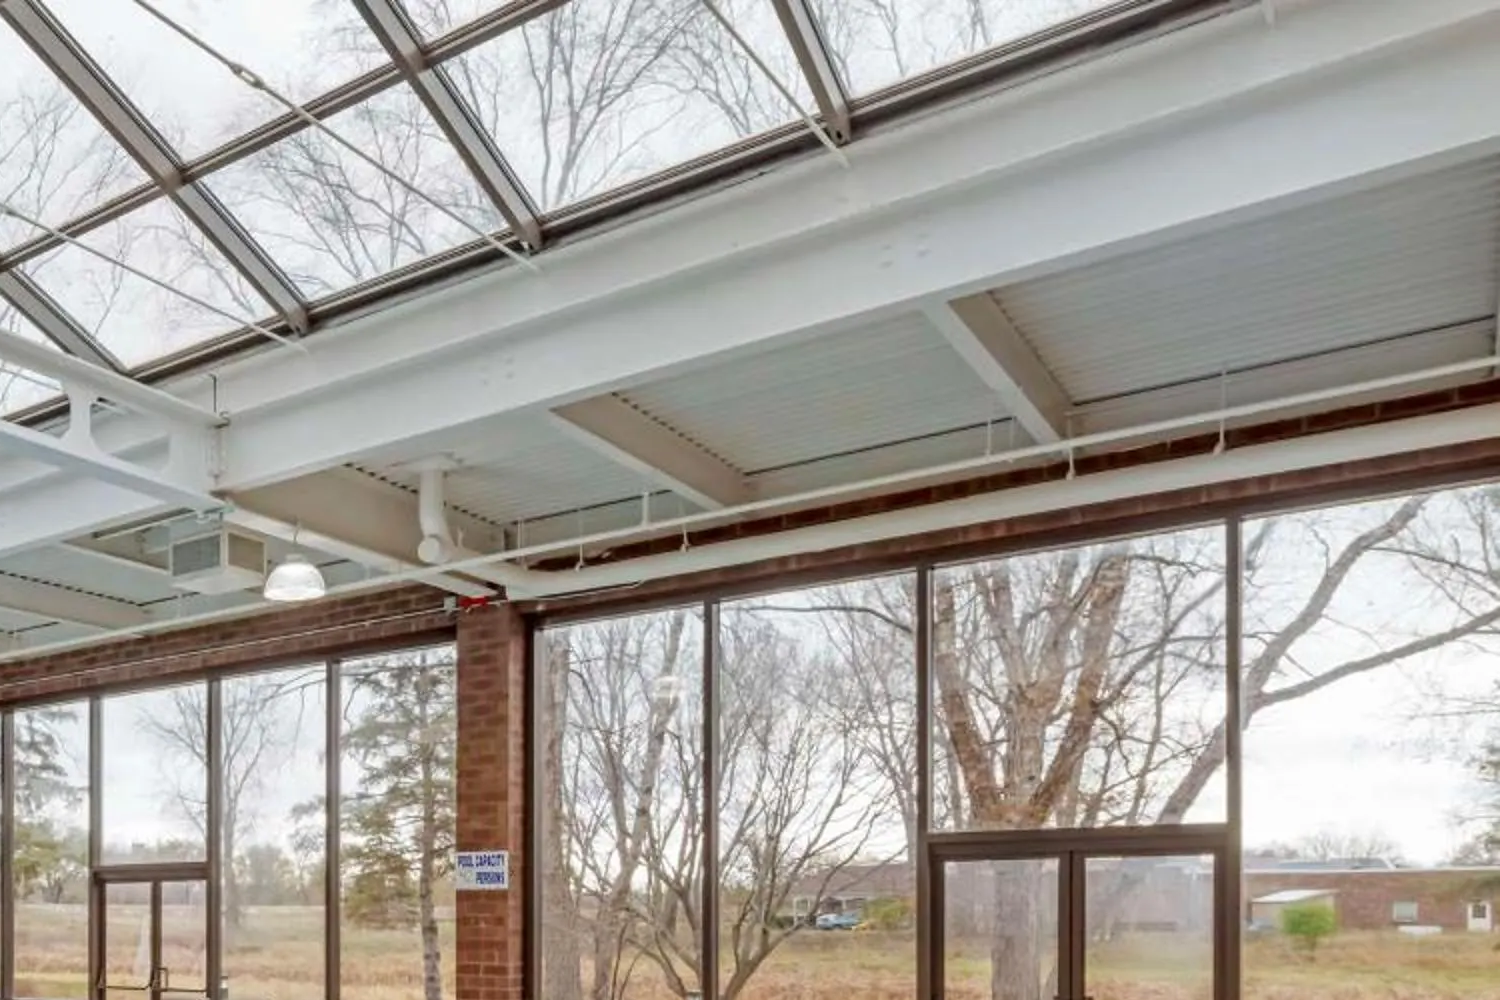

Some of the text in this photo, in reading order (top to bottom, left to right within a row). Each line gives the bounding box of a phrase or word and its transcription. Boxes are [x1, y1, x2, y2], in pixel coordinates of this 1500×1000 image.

[457, 853, 505, 868] POOL CAPACITY
[475, 871, 505, 885] PERSONS
